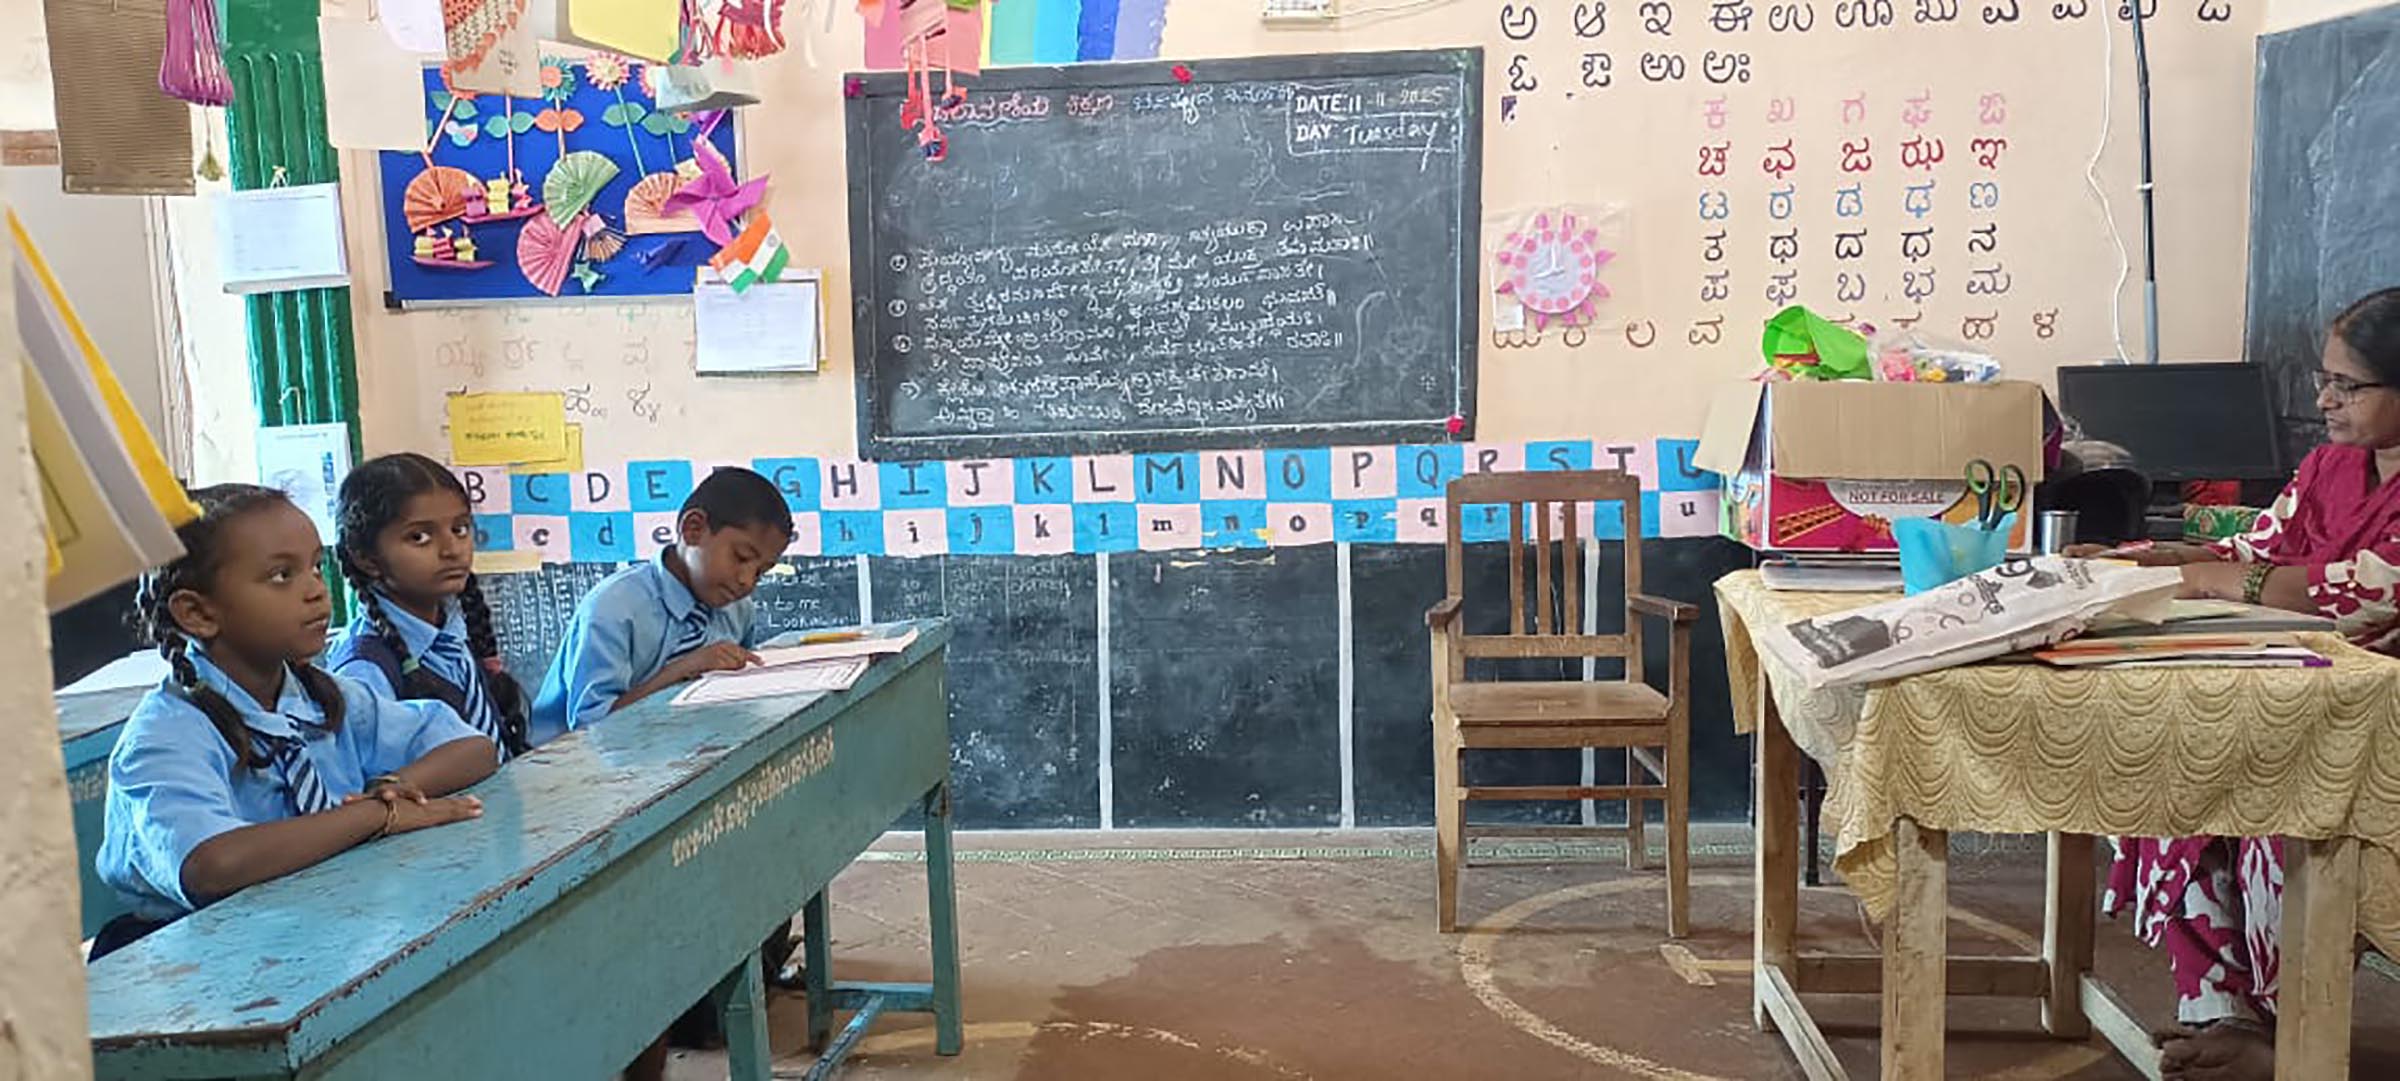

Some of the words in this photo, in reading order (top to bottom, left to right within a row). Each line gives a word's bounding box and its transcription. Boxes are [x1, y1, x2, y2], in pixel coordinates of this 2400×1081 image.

[1501, 5, 1537, 40] ಅ
[1574, 2, 1606, 37] ಆ
[1640, 2, 1672, 36] ಇ
[1709, 0, 1753, 32] ಈ
[1769, 3, 1813, 32] ಉ
[1836, 0, 1893, 27] ಊ
[1508, 55, 1537, 91] ಓ
[1582, 53, 1611, 87] ಔ
[1641, 53, 1685, 81] ಅಂ
[1704, 51, 1750, 83] ಅಃ
[1704, 94, 1730, 130] ಕ
[1767, 96, 1794, 123] ಖ
[1842, 91, 1866, 124] ಗ
[1699, 141, 1730, 176] ಚ
[1842, 137, 1872, 172] ಜ
[1901, 135, 1944, 171] ಝ
[1699, 191, 1729, 220] ಟ
[1770, 184, 1794, 219] ಠ
[1836, 182, 1863, 217] ಡ
[1906, 179, 1936, 218] ಢ
[1970, 182, 1998, 208] ಣ
[1770, 228, 1798, 264] ಥ
[1835, 228, 1867, 259] ದ
[1901, 227, 1933, 263] ಧ
[1968, 223, 1996, 252] ನ
[1701, 270, 1729, 302] ಪ
[1766, 269, 1797, 306] ಫ
[1837, 273, 1865, 302] ಬ
[1903, 267, 1936, 304] ಭ
[1967, 263, 2011, 294] ಮ
[1626, 321, 1655, 348] ಲ
[1689, 314, 1724, 345] ವ
[1962, 311, 1998, 339] ಹ
[2033, 308, 2058, 339] ಳ
[464, 471, 486, 503] B
[526, 474, 548, 502] C
[587, 473, 610, 503] D
[646, 470, 669, 499] E
[773, 466, 801, 498] G
[831, 465, 857, 498] H
[900, 463, 930, 495] I
[963, 462, 989, 496] J
[1031, 461, 1054, 494] K
[1089, 459, 1115, 492] L
[1145, 458, 1184, 493] M
[1217, 456, 1244, 490] N
[1282, 454, 1306, 489] O
[1352, 452, 1373, 488] P
[1417, 449, 1439, 489] Q
[1479, 450, 1498, 473] R
[1607, 447, 1635, 477] T
[1849, 489, 1876, 502] NOT
[1880, 489, 1907, 502] FOR
[1909, 489, 1943, 502] SALE
[532, 528, 549, 545] c
[599, 516, 614, 545] d
[652, 525, 673, 543] e
[839, 519, 854, 541] h
[908, 521, 919, 543] i
[970, 513, 982, 544] j
[1034, 513, 1050, 538] k
[1152, 517, 1172, 532] m
[1224, 516, 1239, 531] n
[1289, 514, 1306, 531] o
[1353, 510, 1369, 529] p
[1421, 507, 1438, 527] q
[1680, 502, 1697, 517] u
